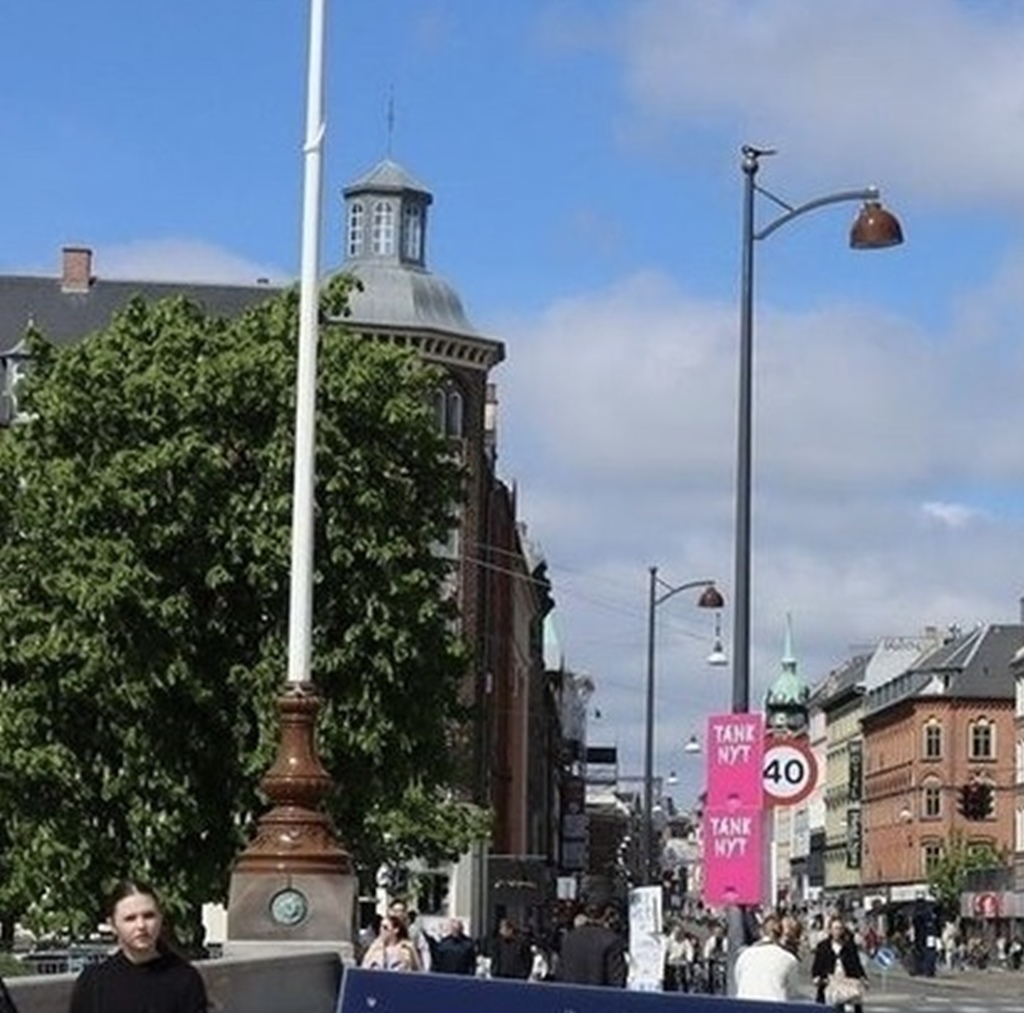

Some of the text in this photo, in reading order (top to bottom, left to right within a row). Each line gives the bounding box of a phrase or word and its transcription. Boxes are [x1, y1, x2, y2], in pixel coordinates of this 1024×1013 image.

[713, 723, 755, 743] TANK
[717, 745, 752, 766] NYT
[763, 759, 805, 785] 40
[710, 817, 752, 837] TANK
[713, 838, 748, 859] NYT
